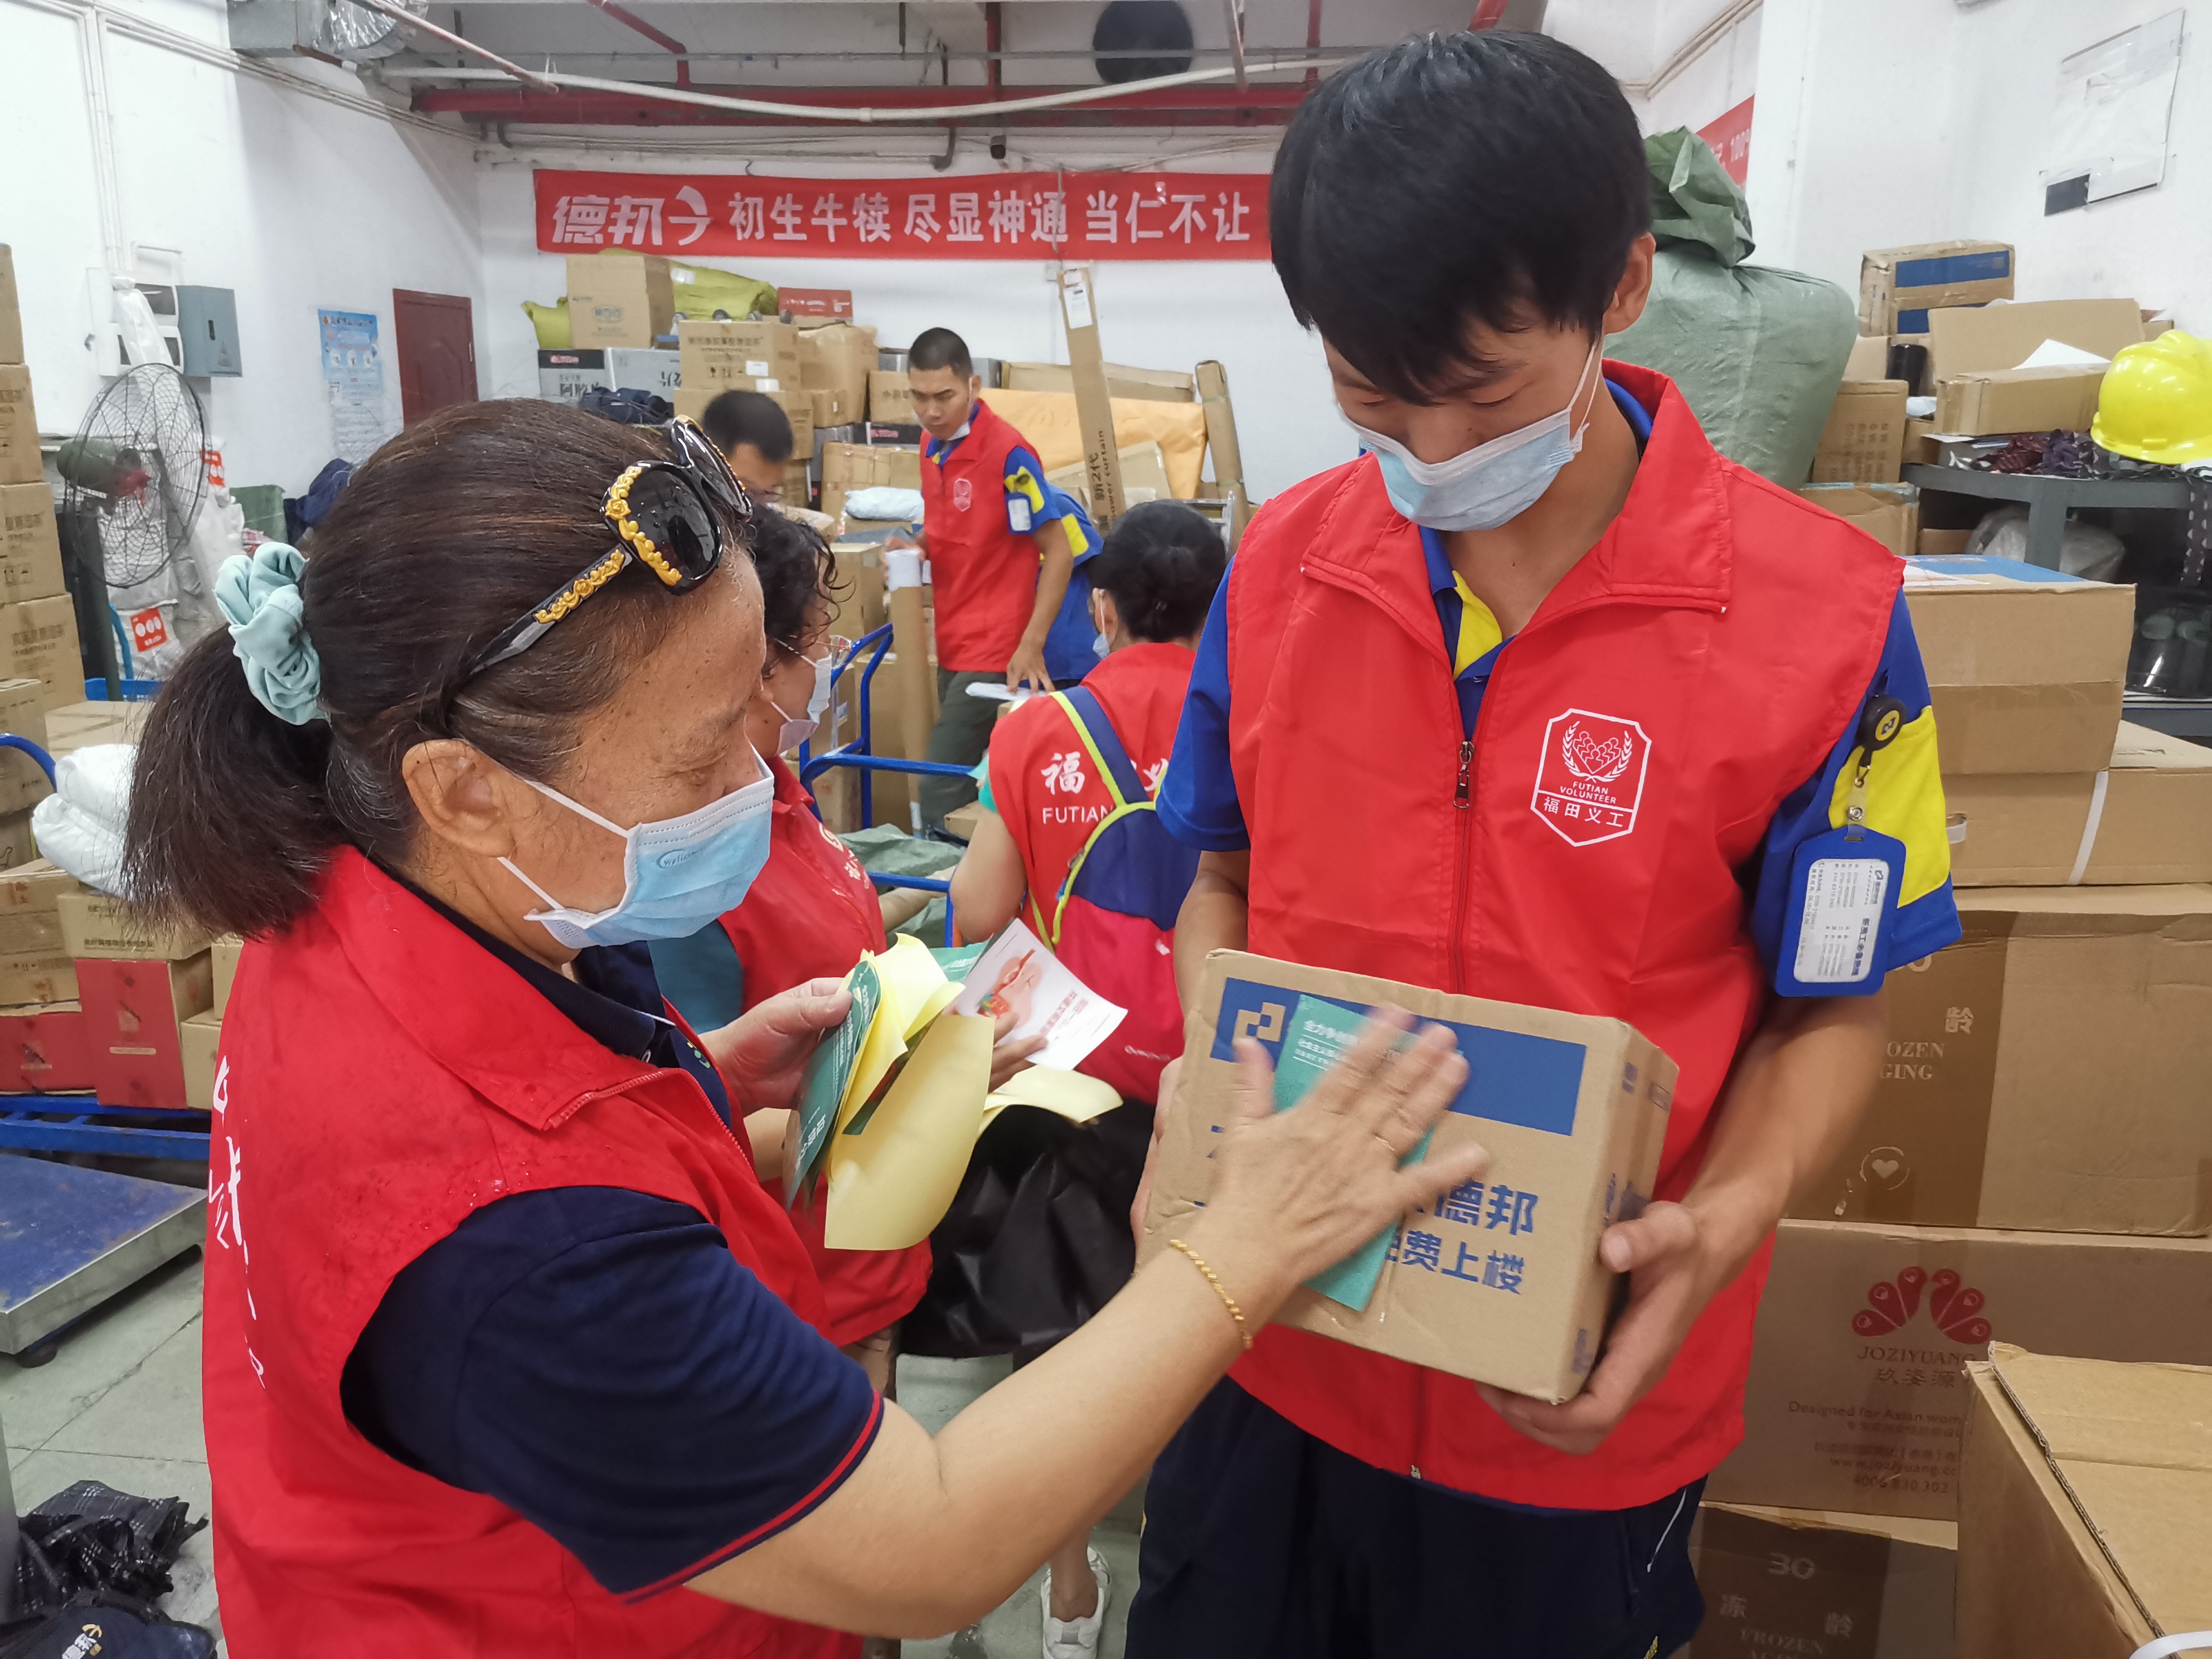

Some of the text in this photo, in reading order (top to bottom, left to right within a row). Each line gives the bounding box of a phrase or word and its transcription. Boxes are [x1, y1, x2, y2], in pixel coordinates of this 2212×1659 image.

[552, 190, 1249, 245] 德邦 初生牛犊 尽显神通 当仁不让
[1560, 786, 1617, 804] VOLUNTEER
[1573, 781, 1609, 795] FUTIAN
[1543, 797, 1624, 827] 福田义工
[1788, 1401, 1855, 1418] Designed
[1859, 1408, 1880, 1419] for
[1884, 1409, 1923, 1422] Asian
[1768, 1551, 1815, 1580] 30
[1740, 1628, 1823, 1655] FROZEN
